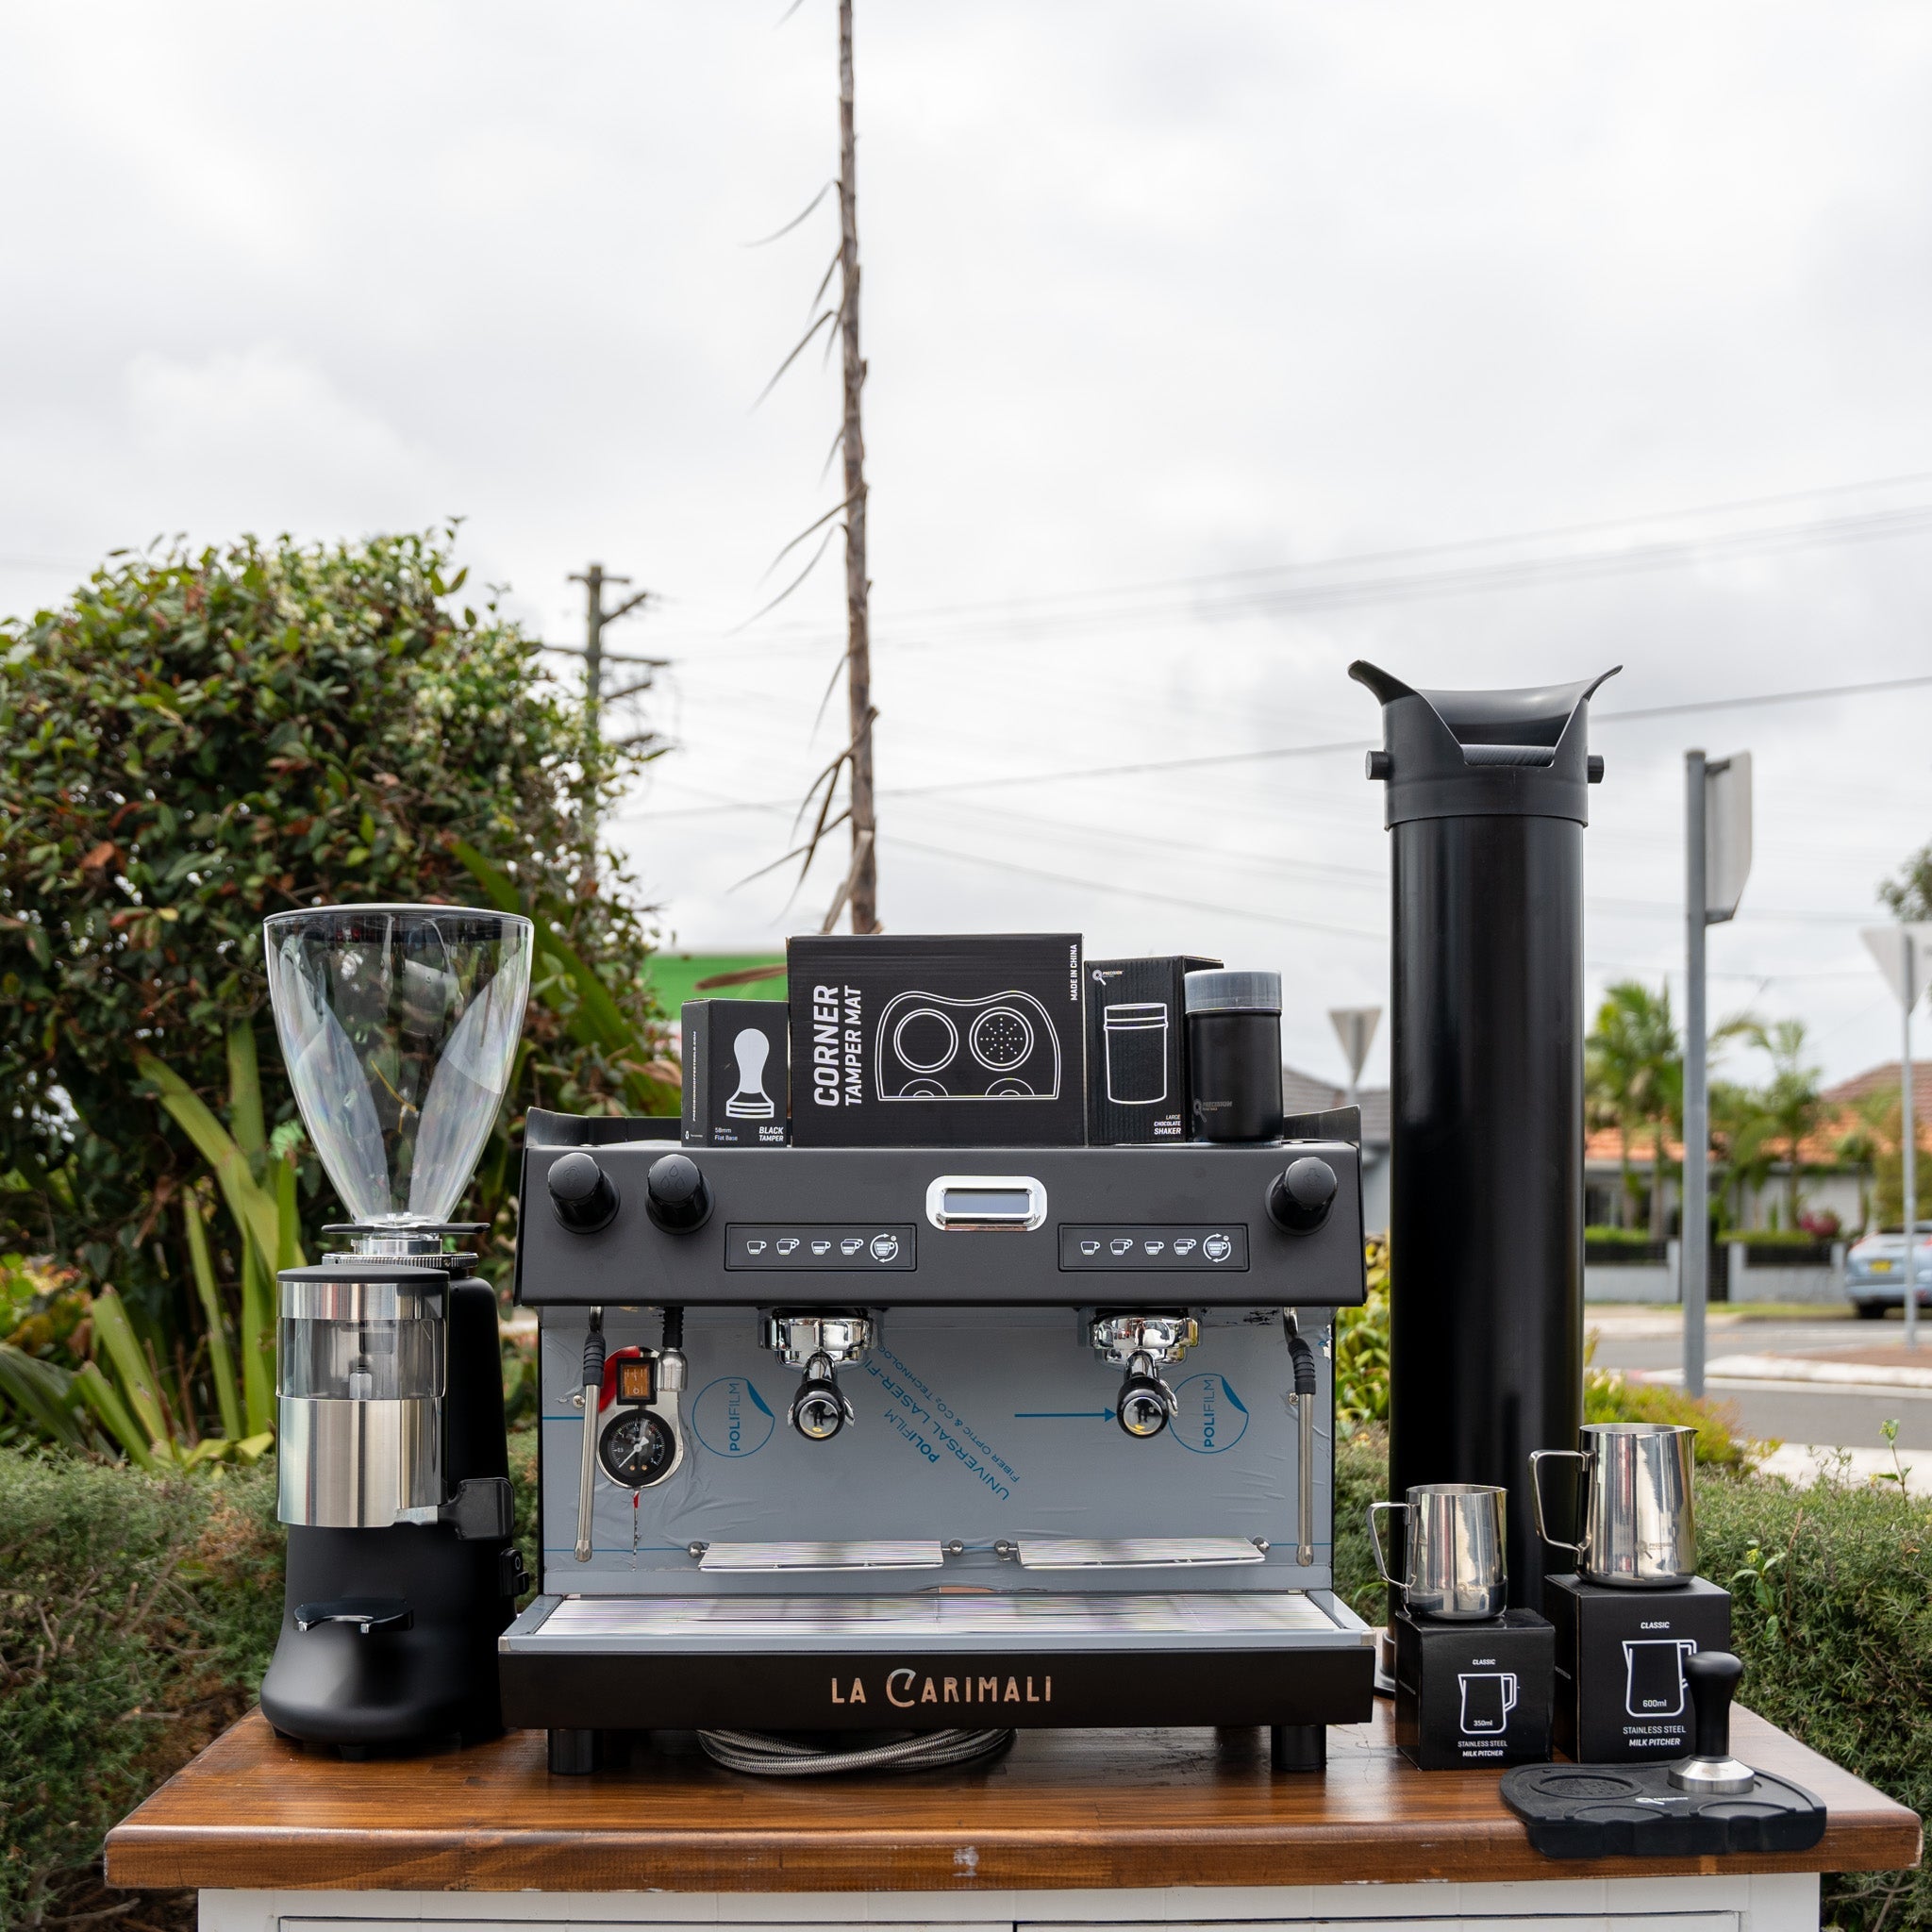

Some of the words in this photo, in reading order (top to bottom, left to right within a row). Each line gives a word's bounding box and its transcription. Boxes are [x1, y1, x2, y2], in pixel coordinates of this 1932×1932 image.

[1070, 944, 1078, 969] CHINA
[844, 985, 861, 1024] MAT
[1070, 978, 1078, 1001] MADE
[813, 985, 840, 1107] CORNER
[844, 1030, 862, 1106] TAMPER
[758, 1126, 784, 1135] BLACK
[729, 1383, 741, 1452] POLIFILM
[954, 1418, 963, 1427] &
[1204, 1379, 1215, 1448] POLIFILM
[884, 1408, 940, 1463] POLIFILM
[963, 1426, 991, 1455] OPTIC
[933, 1421, 1009, 1500] UNIVERSAL
[991, 1454, 1020, 1482] FIBER
[831, 1677, 867, 1704] LA
[886, 1668, 1052, 1708] CARIMALI
[1623, 1726, 1662, 1735] STAINLESS
[1663, 1725, 1687, 1734] STEEL
[1648, 1738, 1681, 1746] PITCHER
